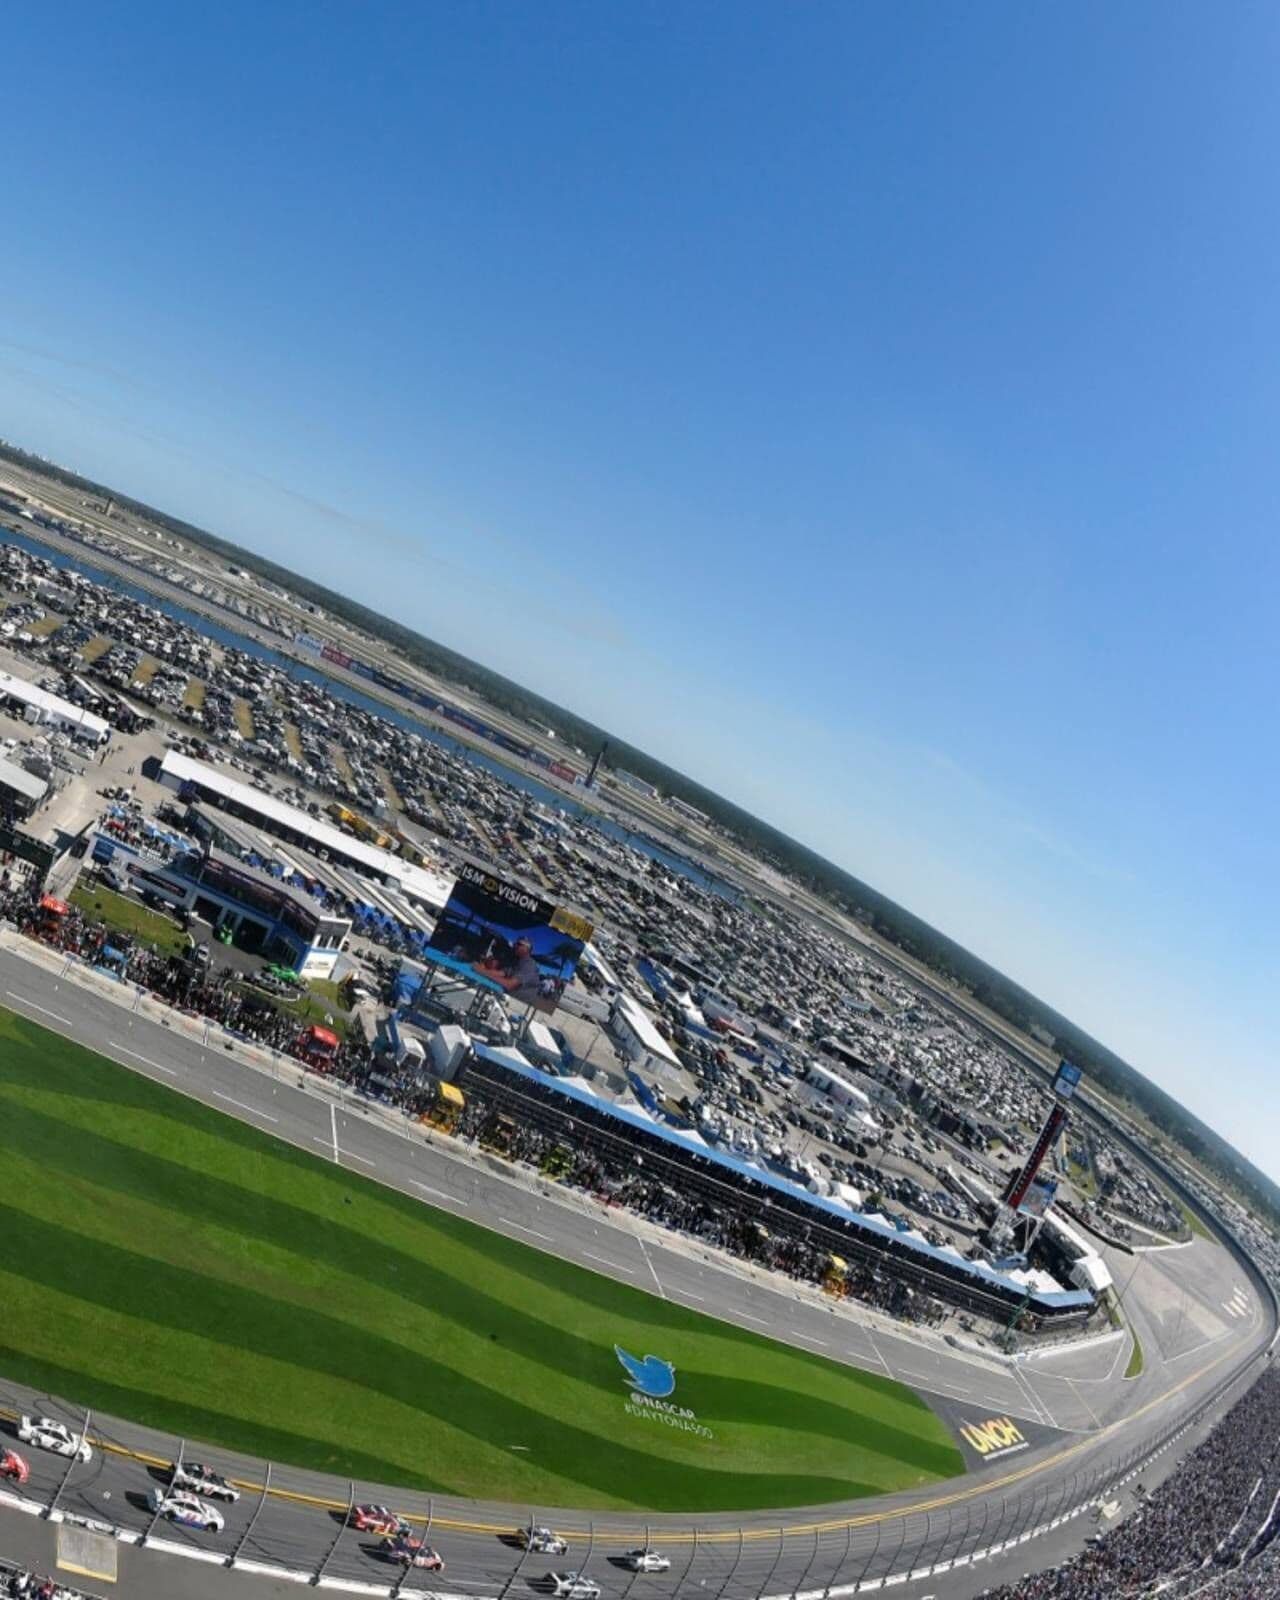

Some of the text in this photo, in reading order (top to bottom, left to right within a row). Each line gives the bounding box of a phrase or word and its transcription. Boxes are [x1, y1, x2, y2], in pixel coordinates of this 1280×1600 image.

[461, 866, 539, 912] ISM VISION
[630, 1392, 697, 1422] @NASCAR
[959, 1416, 1024, 1454] UNOH
